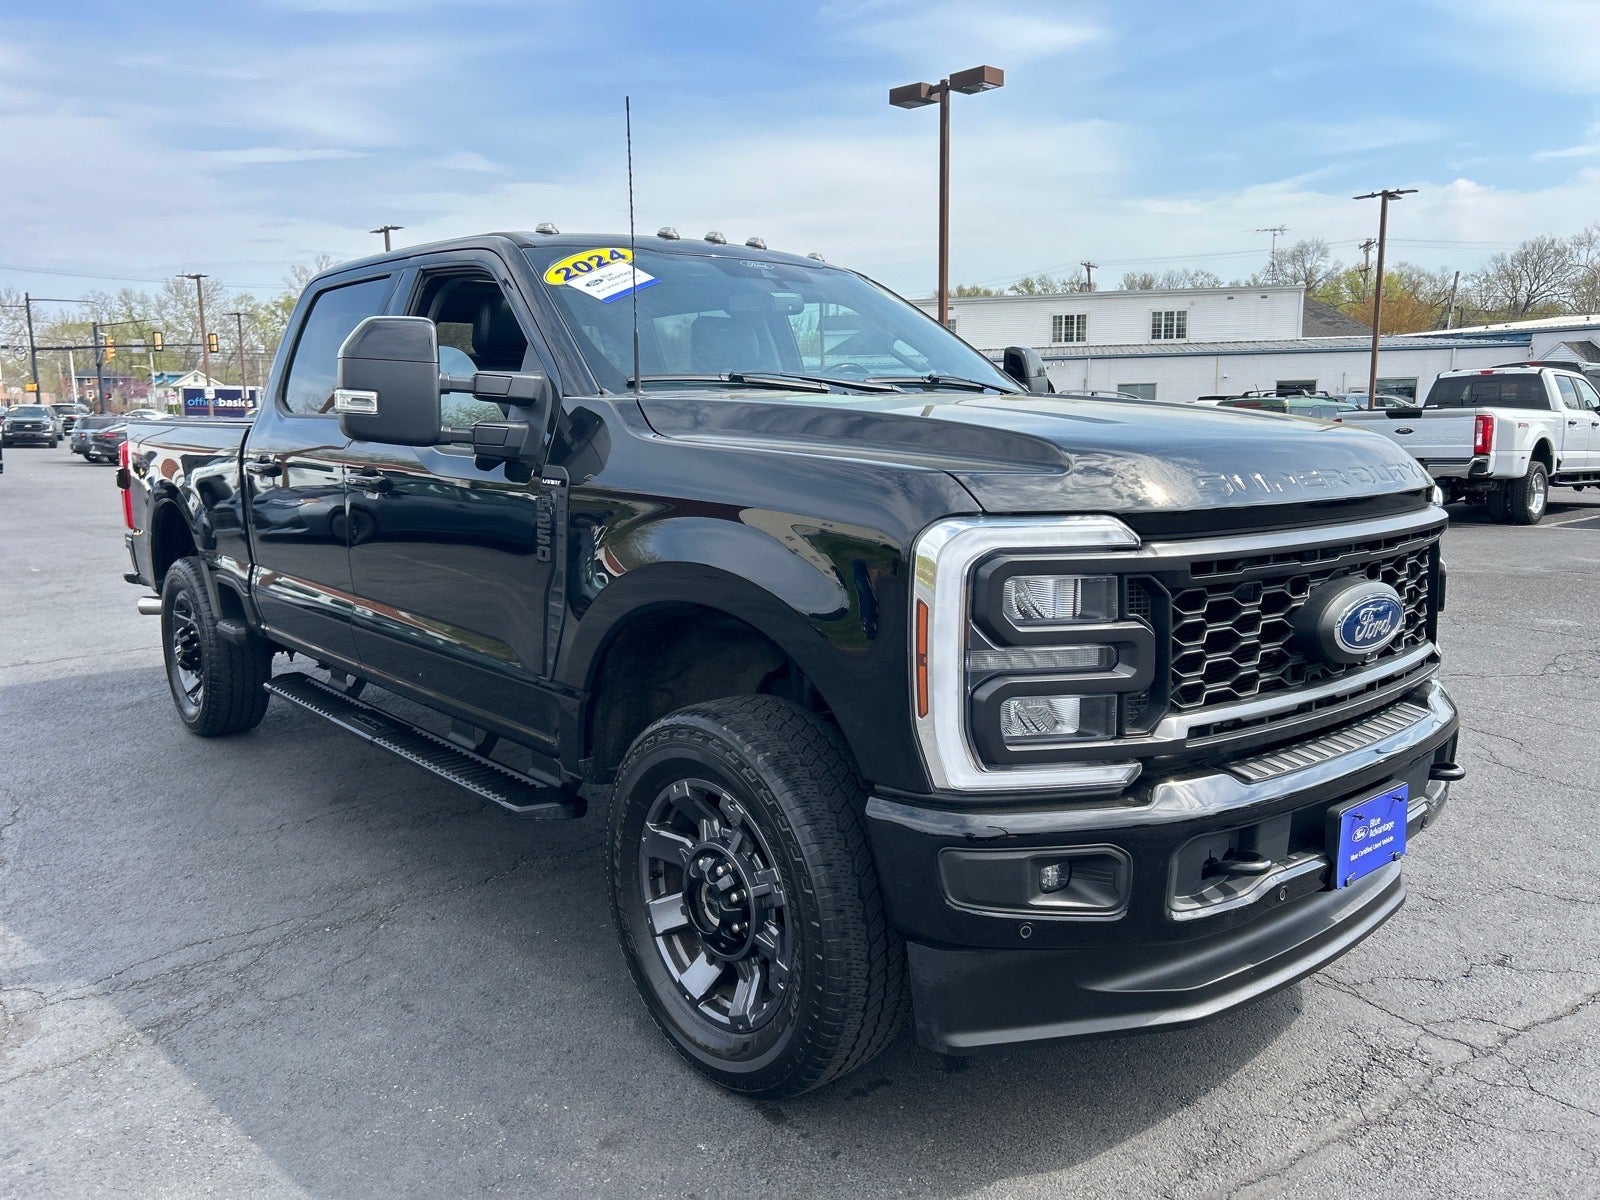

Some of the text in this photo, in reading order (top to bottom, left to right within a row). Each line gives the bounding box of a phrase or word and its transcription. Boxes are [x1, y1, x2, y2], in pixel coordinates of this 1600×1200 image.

[555, 249, 627, 281] 2024
[1355, 606, 1392, 641] Ford
[1370, 817, 1381, 828] Blue
[1370, 821, 1395, 838] Advantage
[1373, 840, 1382, 849] Used
[1382, 835, 1394, 845] Vehicle
